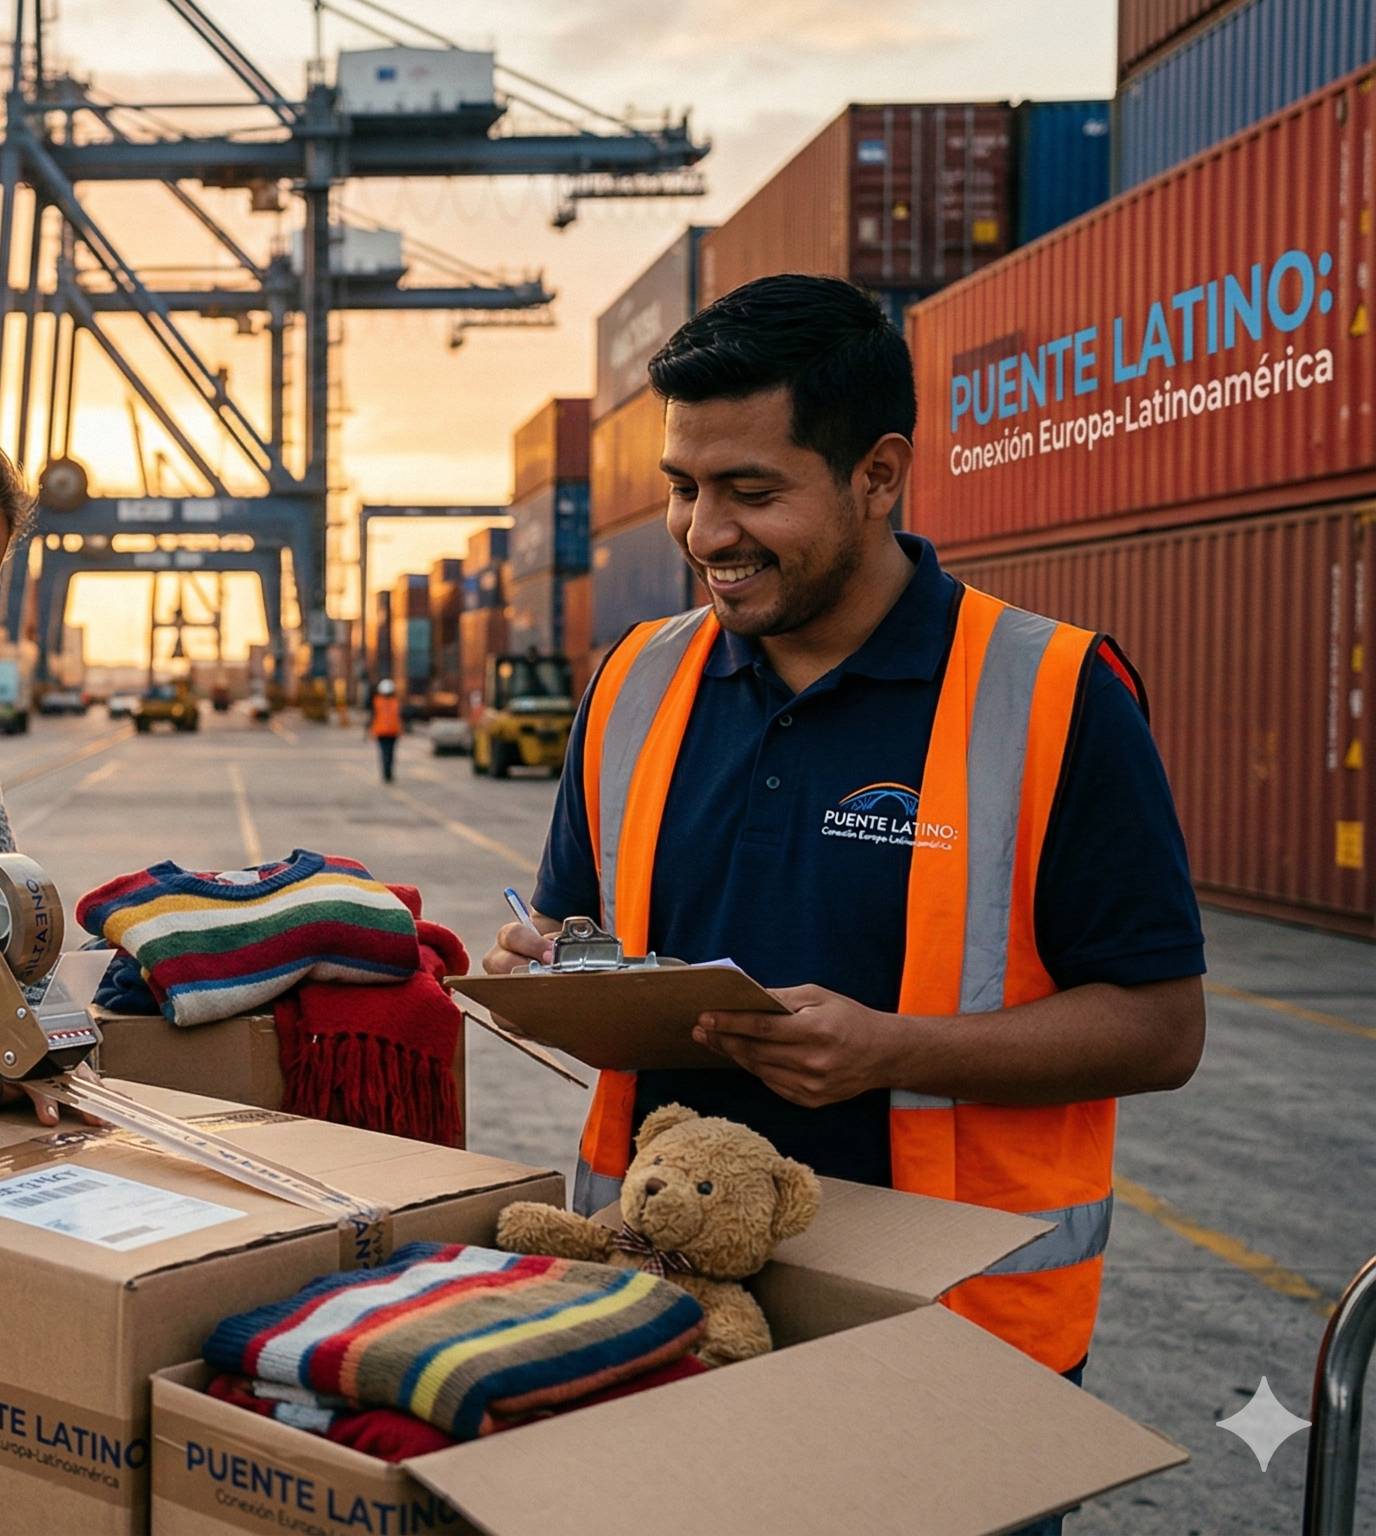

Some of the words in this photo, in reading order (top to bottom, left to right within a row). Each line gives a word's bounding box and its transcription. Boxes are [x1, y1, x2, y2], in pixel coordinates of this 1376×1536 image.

[951, 326, 1098, 433] PUENTE
[1113, 249, 1333, 384] LATINO:
[950, 425, 1034, 475] Conexión
[1039, 345, 1334, 451] Europa-Latinoamérica
[824, 810, 888, 831] PUENTE
[891, 818, 958, 840] LATINO:
[36, 1415, 150, 1470] LATINO
[186, 1441, 317, 1513] PUENTE
